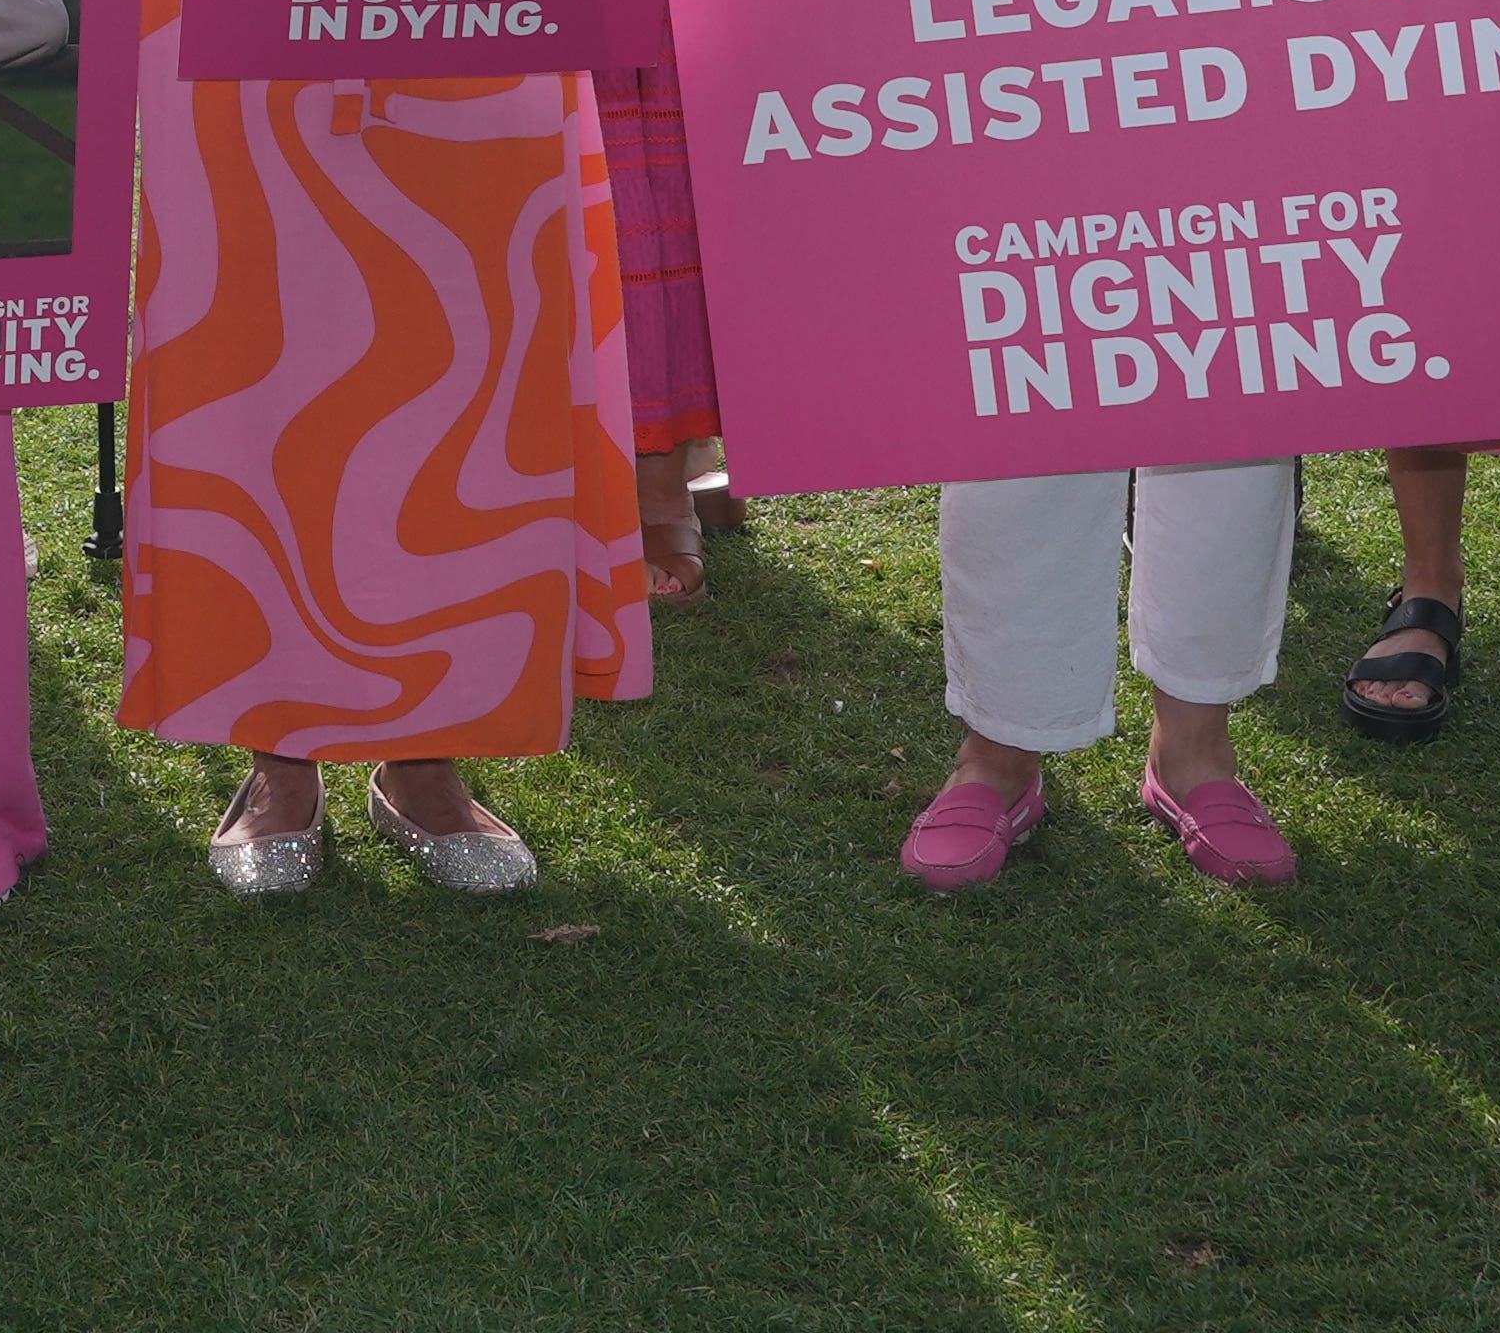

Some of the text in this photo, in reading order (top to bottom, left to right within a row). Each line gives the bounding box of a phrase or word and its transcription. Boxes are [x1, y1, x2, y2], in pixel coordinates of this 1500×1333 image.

[289, 1, 558, 40] IN DYING.
[743, 47, 1247, 164] ASSISTED
[955, 188, 1400, 264] CAMPAIGN FOR
[37, 296, 89, 315] FOR
[958, 233, 1403, 343] DIGNITY
[969, 313, 1450, 416] IN DYING.
